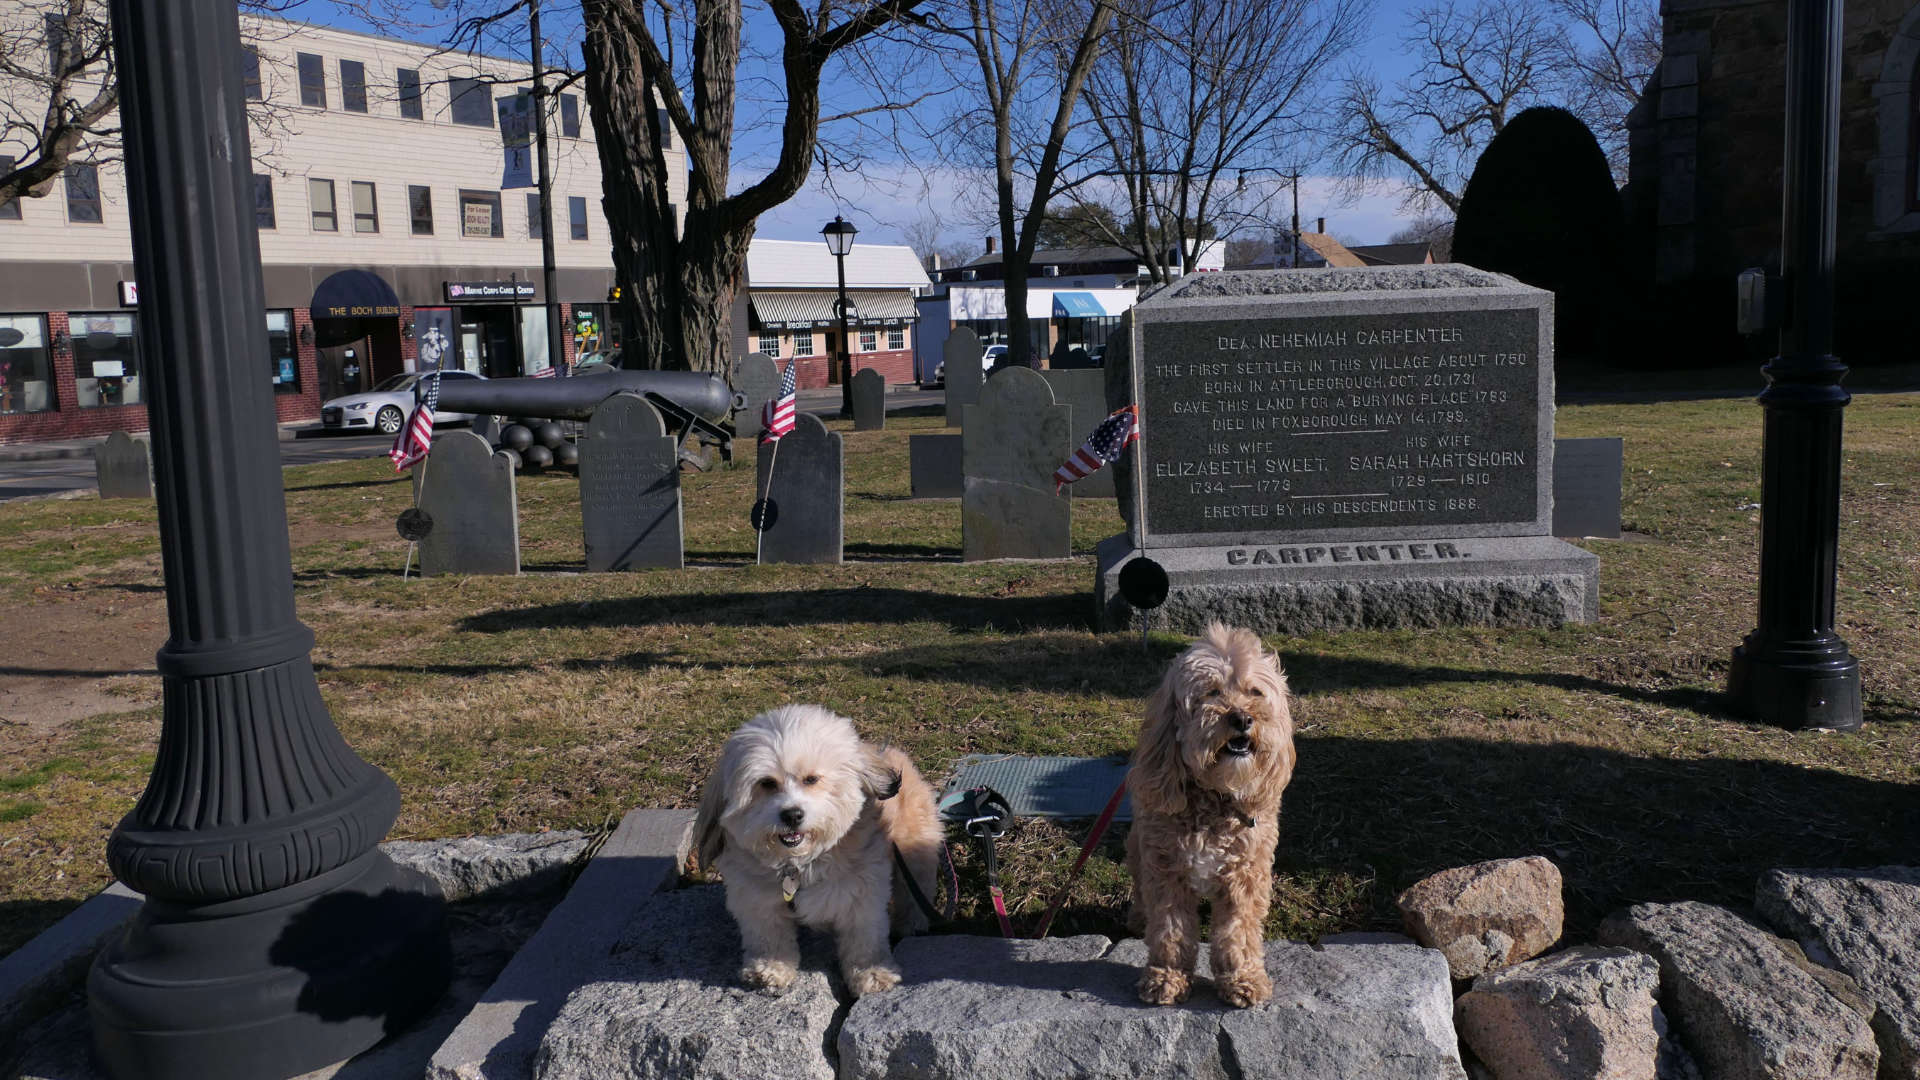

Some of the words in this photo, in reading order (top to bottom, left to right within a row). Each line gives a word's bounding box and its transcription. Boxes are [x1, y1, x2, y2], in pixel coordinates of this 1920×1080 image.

[464, 286, 482, 295] MARINE
[483, 286, 499, 295] CORPS
[517, 286, 534, 295] CENTER
[329, 306, 347, 316] THE
[351, 306, 373, 316] BOCH
[375, 306, 399, 315] BUILDING
[577, 310, 592, 318] Open
[786, 319, 813, 329] Breakfast
[883, 318, 899, 326] Lunch
[1218, 336, 1255, 350] DEA.
[1260, 331, 1347, 348] NEHEMIAH
[1357, 327, 1464, 345] CARPENTER
[1155, 364, 1183, 377] THE
[1190, 363, 1230, 376] FIRST
[1237, 361, 1302, 375] SETTLER
[1309, 359, 1322, 372] IN
[1330, 358, 1361, 371] THIS
[1370, 355, 1432, 370] VILLAGE
[1438, 353, 1488, 368] ABOUT
[1495, 353, 1528, 366] 1750
[1205, 380, 1243, 394] BORN
[1250, 379, 1263, 393] IN
[1174, 401, 1211, 414] GAVE
[1218, 400, 1249, 412] THIS
[1256, 398, 1294, 411] LAND
[1301, 396, 1328, 409] FOR
[1336, 396, 1346, 408] A
[1213, 417, 1245, 431] DIED
[1252, 416, 1265, 430] IN
[1272, 414, 1368, 429] FOXBOROUGH
[1375, 413, 1403, 426] MAY
[1209, 443, 1230, 455] HIS
[1239, 441, 1273, 453] WIFE
[1405, 436, 1428, 448] HIS
[1438, 435, 1472, 447] WIFE
[1349, 454, 1409, 470] SARAH
[1418, 450, 1526, 469] HARTSHORN
[1156, 459, 1257, 477] ELIZABETH
[1190, 481, 1225, 494] 1734
[1391, 475, 1426, 488] 1729
[1460, 473, 1490, 486] 1810
[1204, 504, 1269, 518] ERECTED
[1276, 502, 1295, 516] BY
[1303, 502, 1325, 515] HIS
[1333, 499, 1437, 514] DESCENDENTS
[1227, 542, 1472, 566] CARPENTER.
